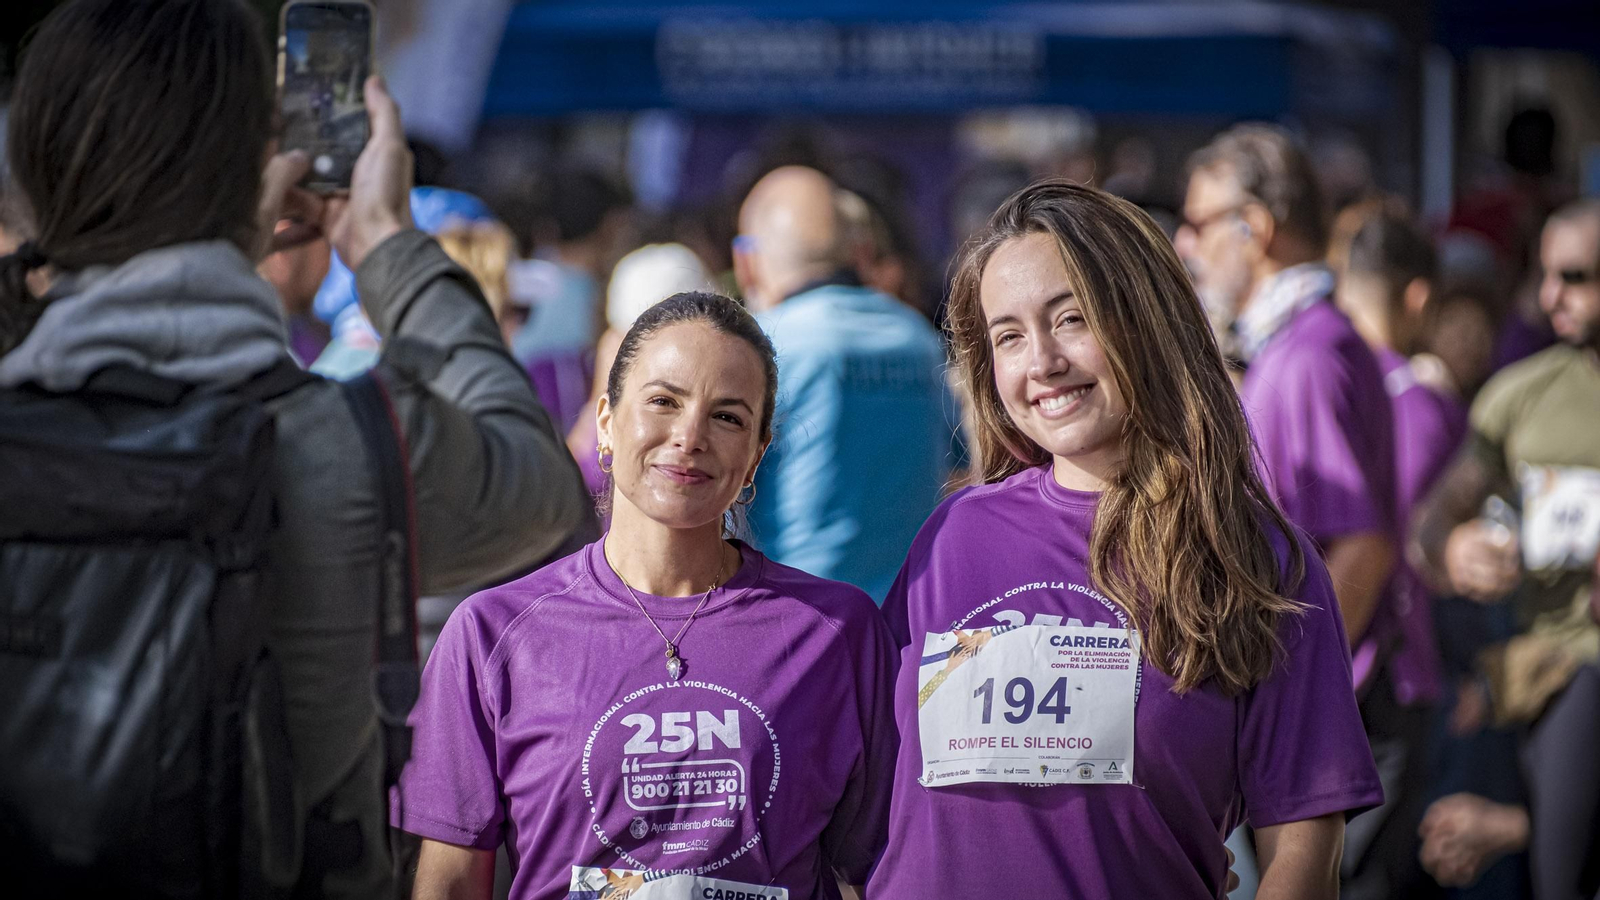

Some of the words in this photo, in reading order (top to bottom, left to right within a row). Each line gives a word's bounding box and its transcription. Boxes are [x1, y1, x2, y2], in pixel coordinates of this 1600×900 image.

[954, 596, 1003, 630] NACIONAL
[1004, 581, 1048, 598] CONTRA
[1051, 581, 1064, 589] LA
[1067, 582, 1117, 612] VIOLENCIA
[1049, 635, 1132, 649] CARRERA
[623, 683, 665, 703] CONTRA
[683, 680, 738, 699] VIOLENCIA
[739, 696, 766, 721] HACIA
[973, 676, 1072, 725] 194
[581, 702, 624, 775] INTERNACIONAL
[620, 709, 741, 755] 25N
[763, 720, 777, 741] LAS
[948, 736, 997, 751] ROMPE
[1001, 736, 1019, 748] EL
[1023, 736, 1093, 749] SILENCIO
[631, 774, 664, 783] UNIDAD
[664, 772, 696, 781] ALERTA
[697, 771, 707, 779] 24
[708, 770, 737, 778] HORAS
[769, 743, 781, 792] MUJERES
[581, 777, 593, 797] DÍA
[631, 782, 670, 799] 900
[672, 780, 690, 797] 21
[693, 779, 712, 795] 21
[715, 778, 738, 794] 30
[651, 820, 701, 834] Ayuntamiento
[701, 819, 711, 829] de
[712, 817, 735, 828] Cádiz
[614, 846, 652, 872] CONTR
[731, 831, 762, 860] MACHI
